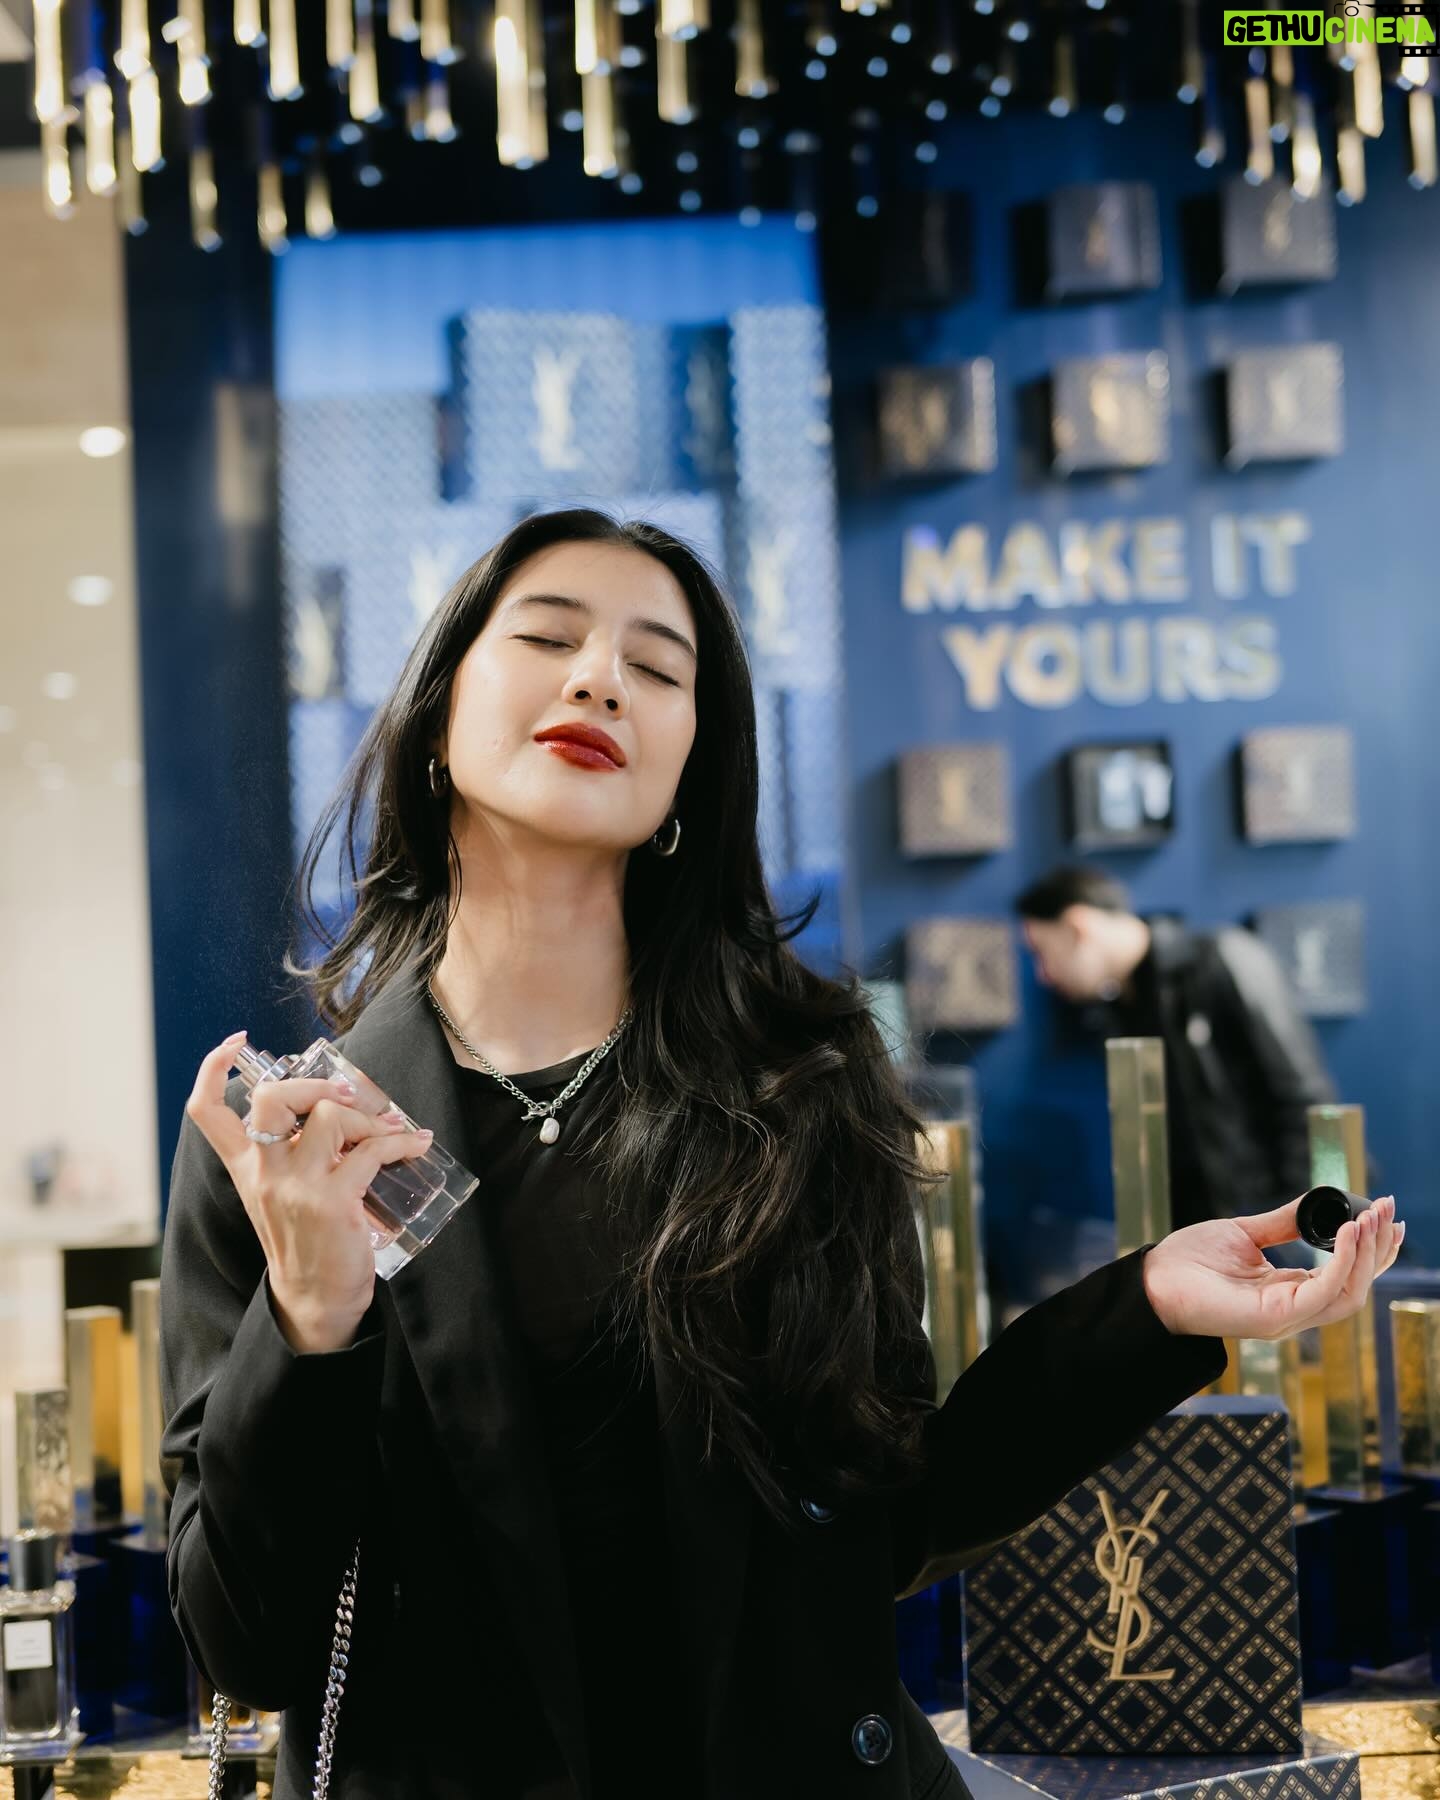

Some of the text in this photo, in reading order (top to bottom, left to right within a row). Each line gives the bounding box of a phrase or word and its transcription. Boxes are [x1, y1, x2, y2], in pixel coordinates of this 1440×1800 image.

[902, 517, 1188, 613] MAKE
[1210, 512, 1309, 598] IT
[941, 615, 1282, 711] YOURS
